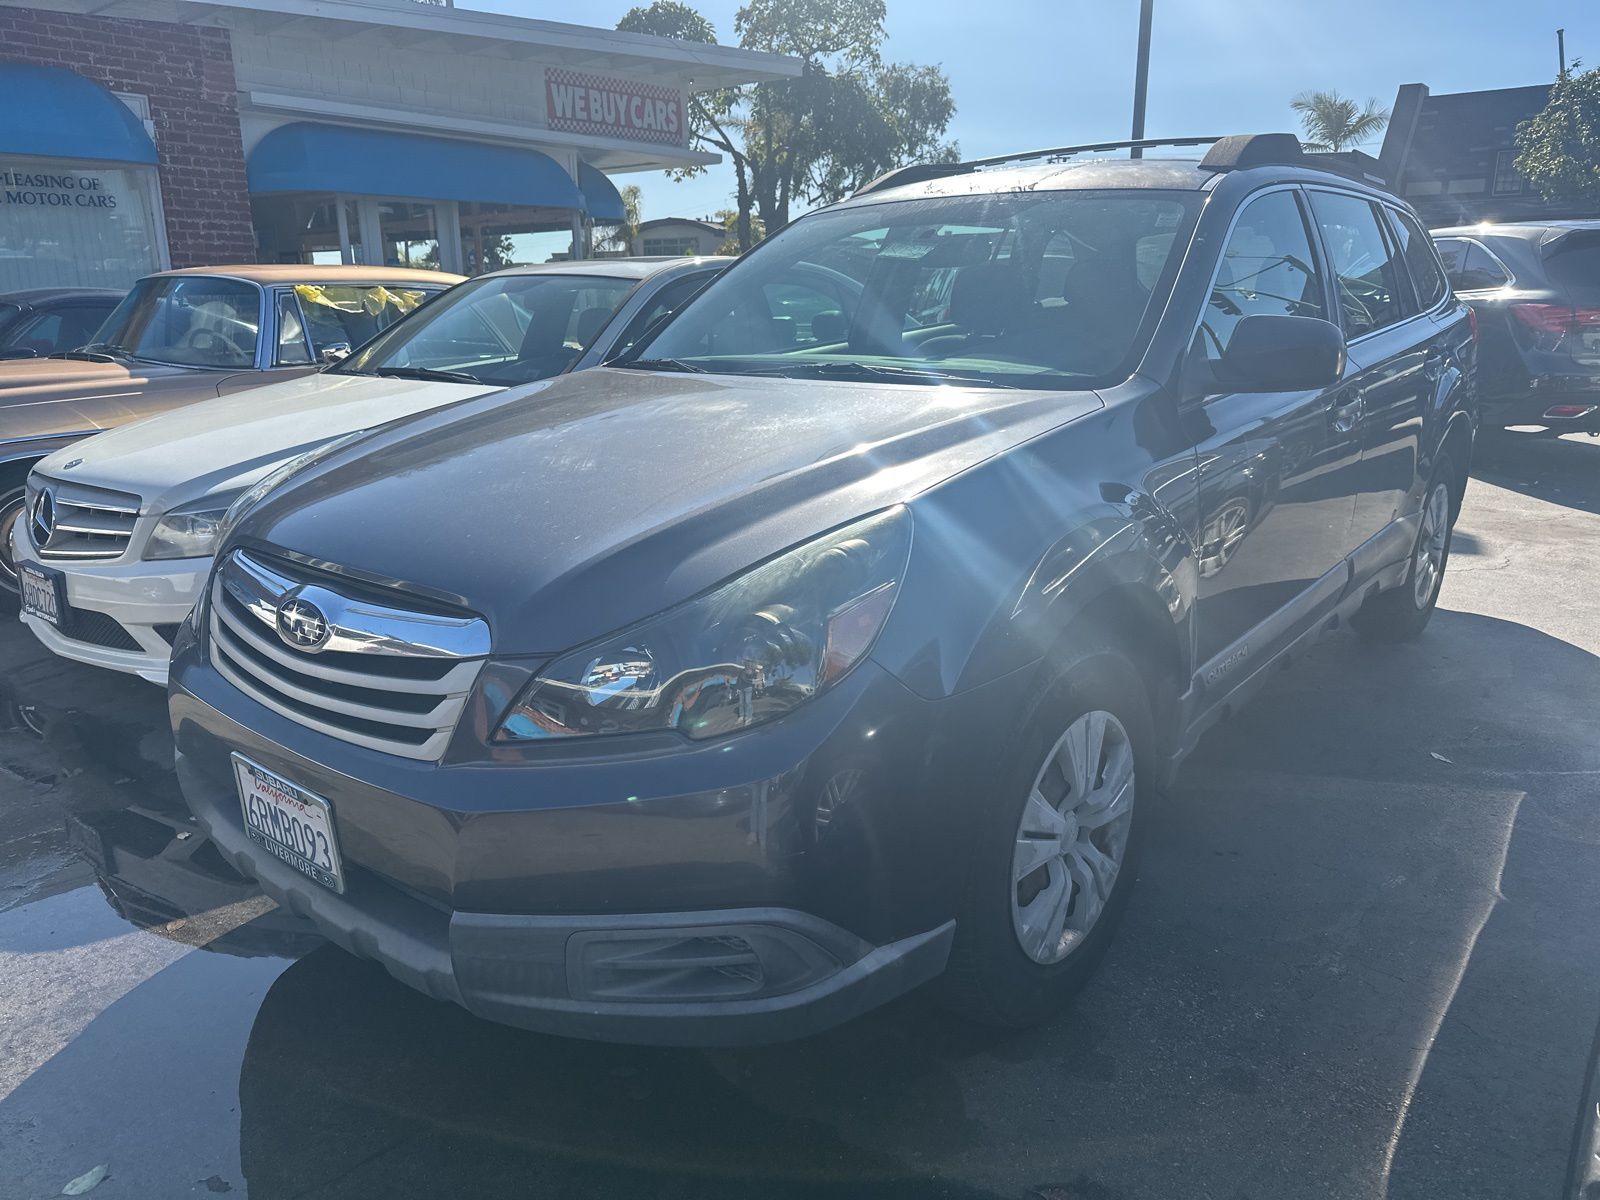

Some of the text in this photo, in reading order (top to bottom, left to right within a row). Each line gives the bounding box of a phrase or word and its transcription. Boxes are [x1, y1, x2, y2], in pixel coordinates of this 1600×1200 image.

[550, 83, 677, 133] WE BUY CARS
[5, 190, 117, 208] MOTOR CARS
[79, 177, 100, 190] OF
[254, 768, 298, 799] SUBARU
[249, 794, 332, 872] 6RMB093
[264, 838, 319, 879] LIVERMORE
